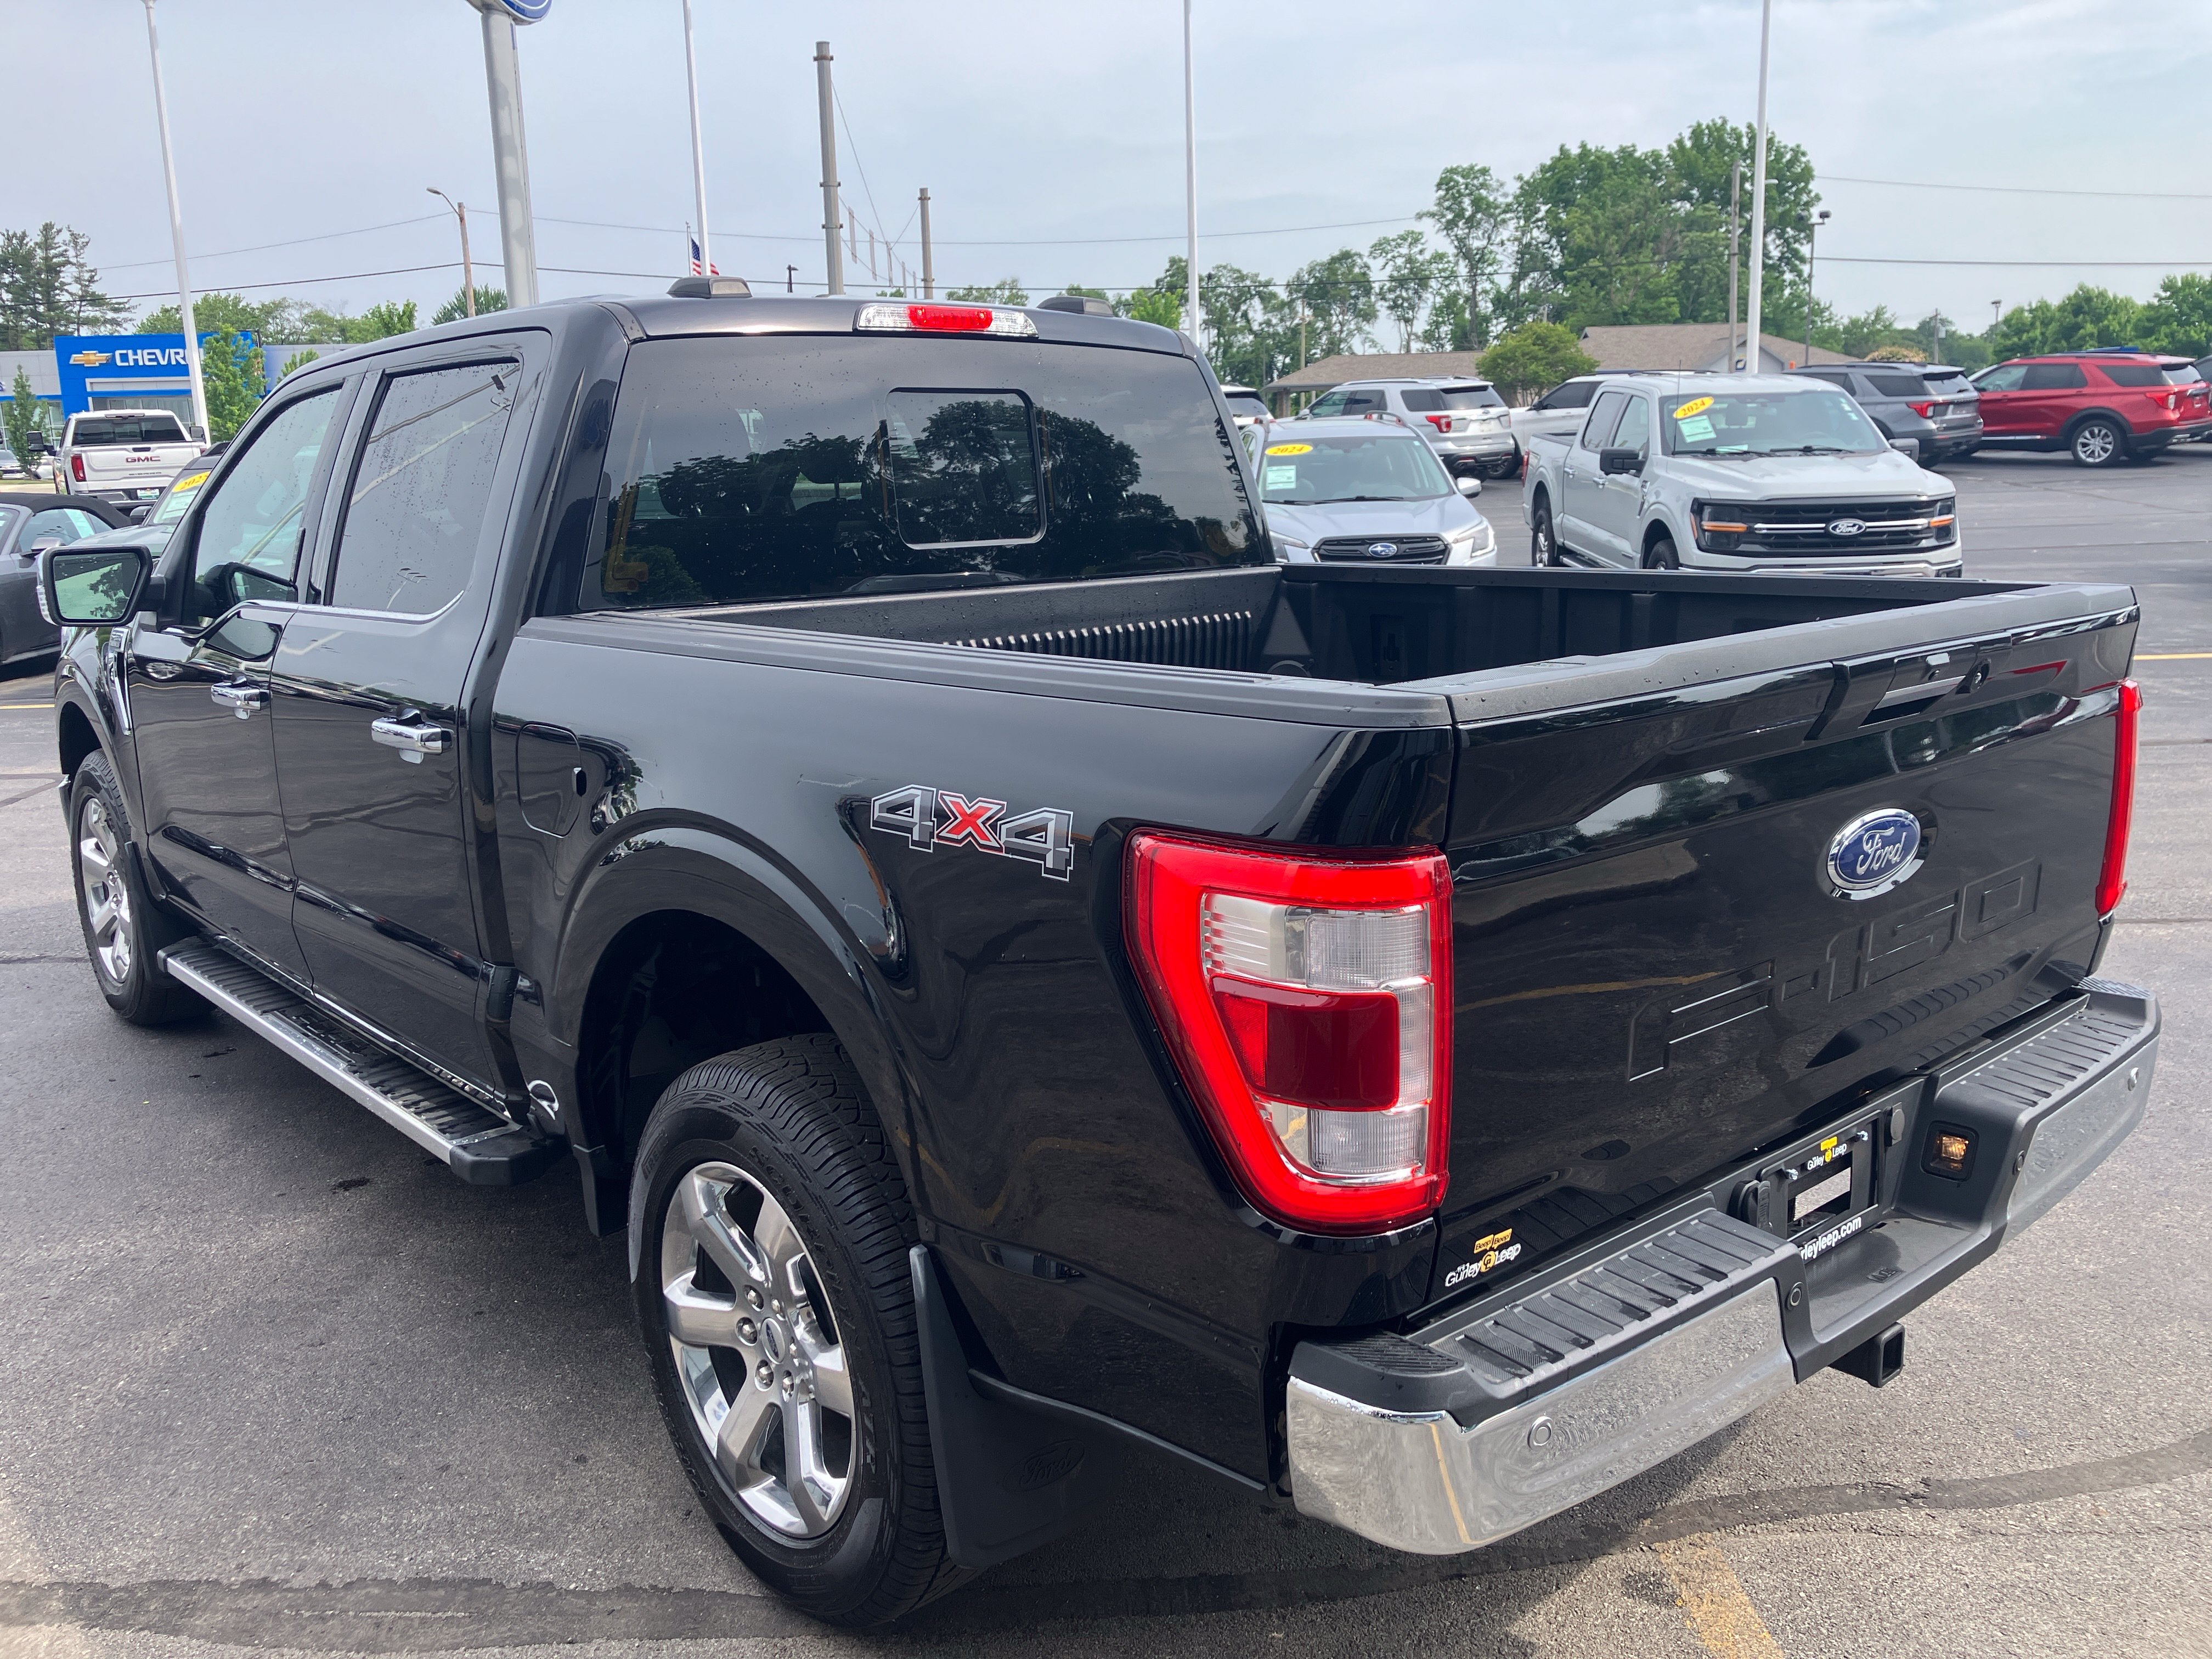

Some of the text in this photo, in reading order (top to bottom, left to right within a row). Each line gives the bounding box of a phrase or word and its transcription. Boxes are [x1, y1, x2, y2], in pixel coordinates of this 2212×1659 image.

[115, 348, 190, 366] CHEVR
[1681, 399, 1706, 416] 2024
[1272, 445, 1305, 455] 2024
[1836, 522, 1859, 533] Ford
[1856, 826, 1907, 876] Ford
[1627, 857, 2042, 1082] F-150
[1832, 1143, 1847, 1158] Leep
[1800, 1216, 1862, 1260] rleyleep.com
[1444, 1260, 1482, 1287] Gurley
[1494, 1243, 1521, 1266] Leep
[1019, 1446, 1072, 1487] Ford
